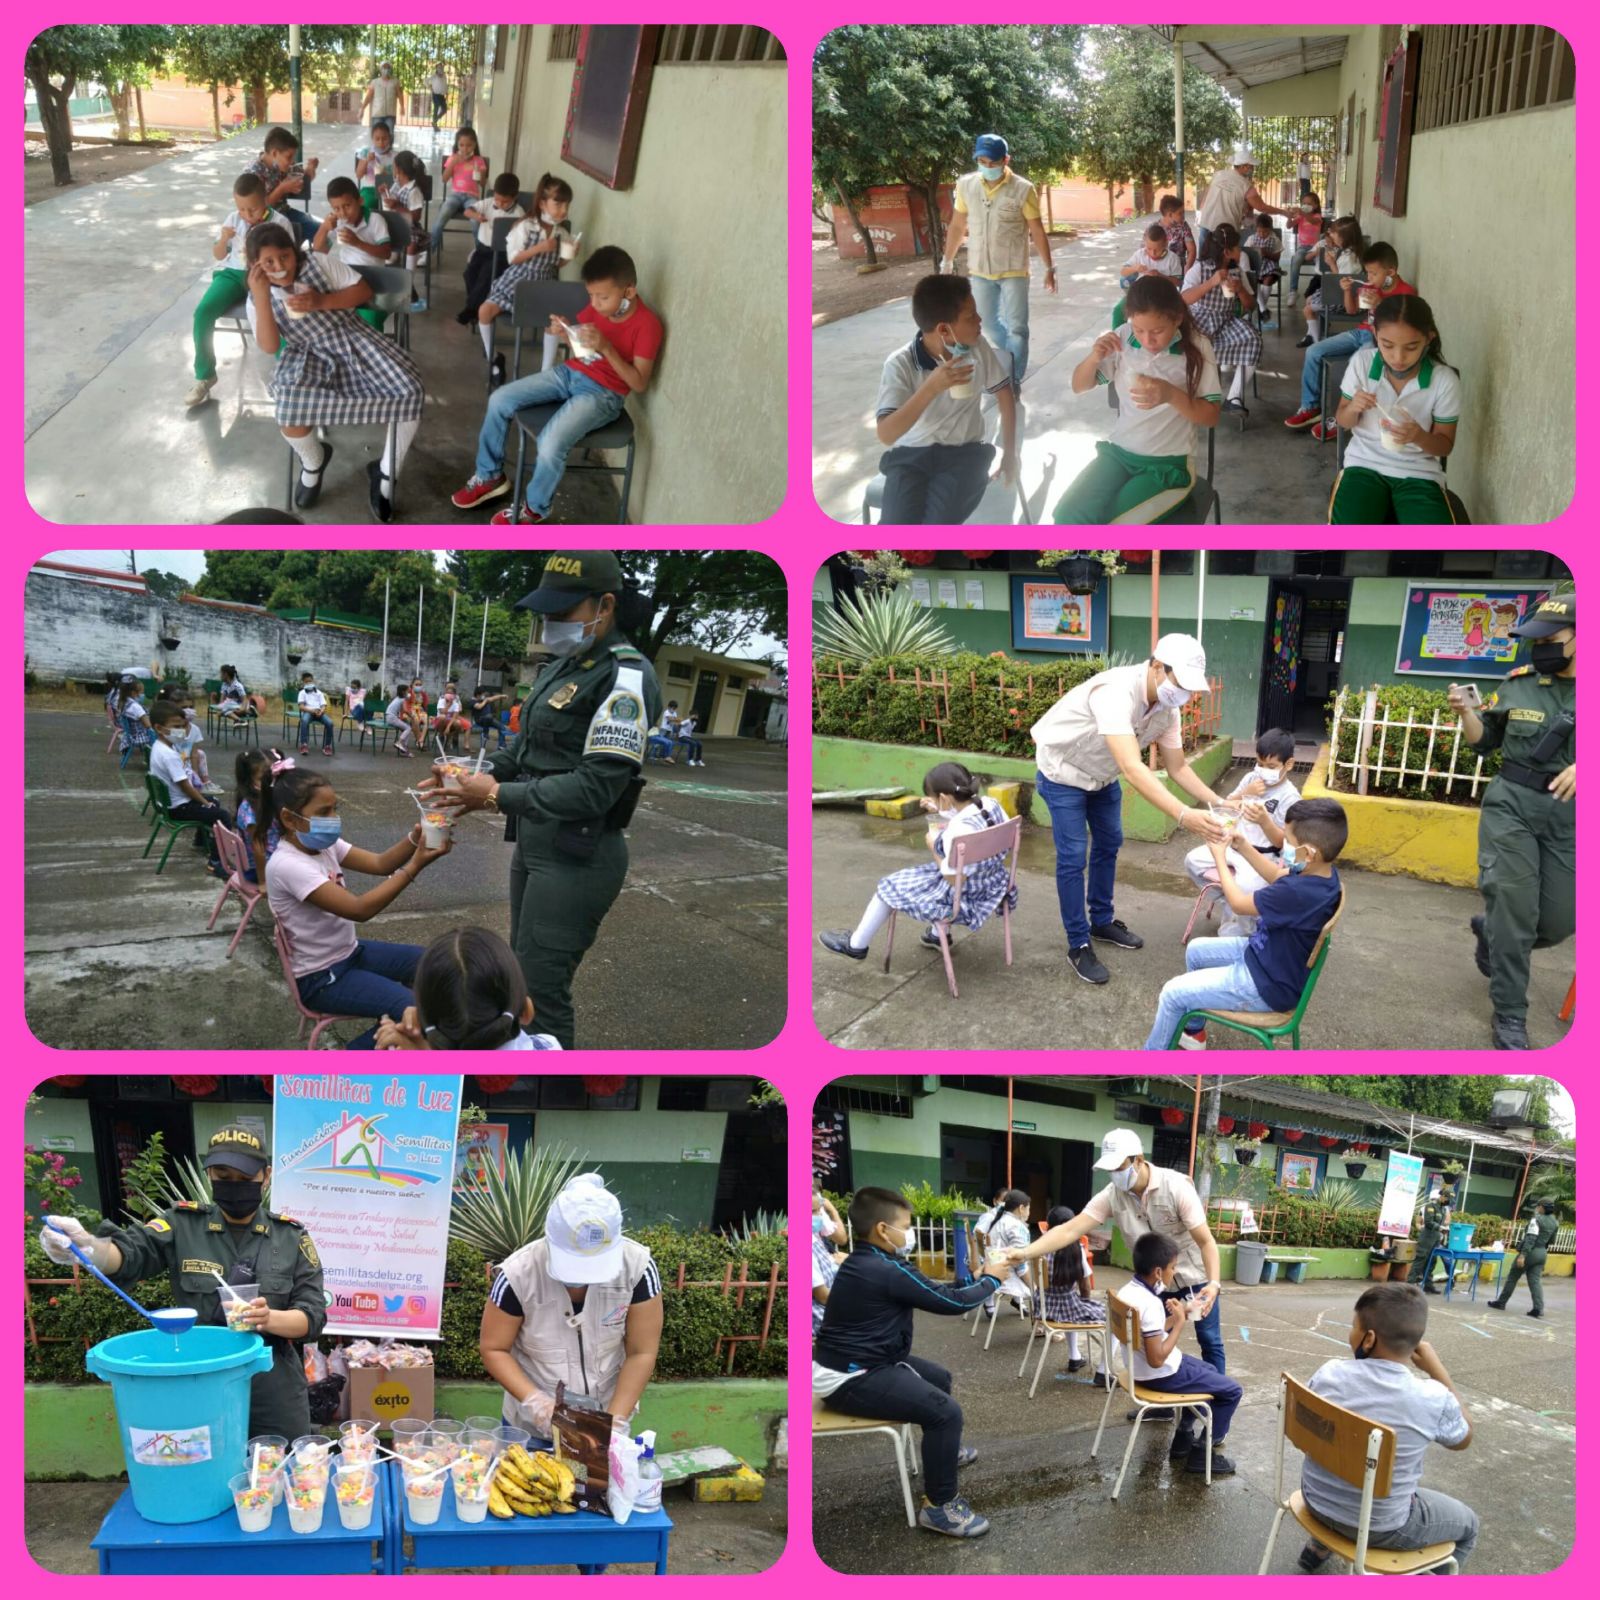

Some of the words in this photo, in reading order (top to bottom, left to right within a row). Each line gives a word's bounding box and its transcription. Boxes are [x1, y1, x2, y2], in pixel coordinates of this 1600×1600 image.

[852, 229, 896, 243] PNY
[592, 725, 638, 741] INFANCIA
[281, 1074, 371, 1104] Semillitas
[384, 1078, 406, 1106] de
[418, 1081, 453, 1111] Luz
[210, 1129, 260, 1149] POLICIA
[280, 1119, 341, 1168] Fundación
[396, 1135, 451, 1150] Semillitas
[421, 1153, 441, 1164] Luz
[331, 1186, 357, 1194] respeto
[366, 1188, 396, 1197] nuestros
